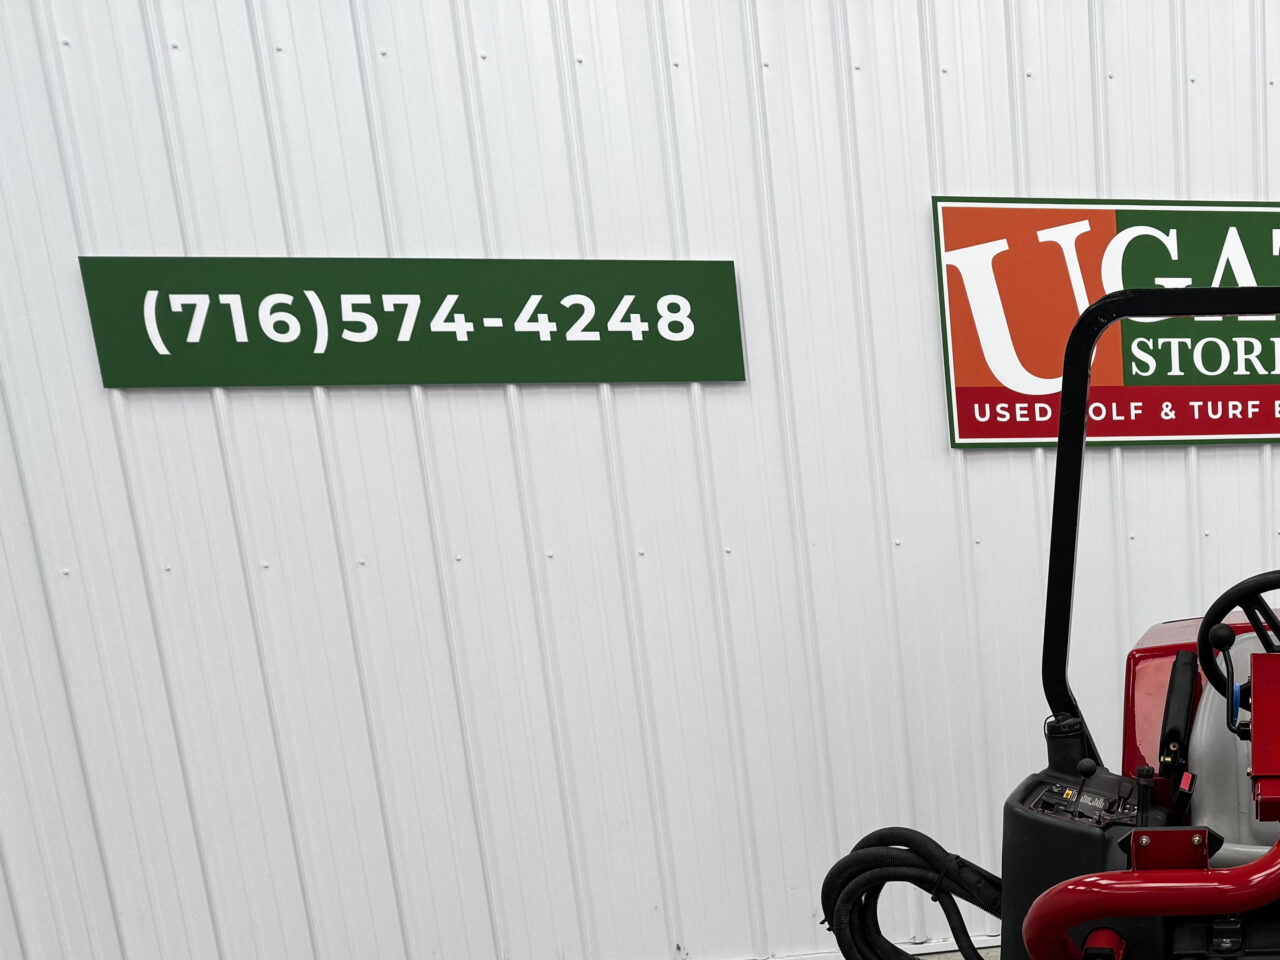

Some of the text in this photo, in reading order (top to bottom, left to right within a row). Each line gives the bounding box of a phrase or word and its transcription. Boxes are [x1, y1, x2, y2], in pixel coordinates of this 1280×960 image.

[143, 290, 696, 355] (716)574-4248
[974, 403, 1052, 422] USED
[1088, 402, 1143, 421] OLF
[1161, 401, 1176, 420] &
[1189, 400, 1260, 420] TURF
